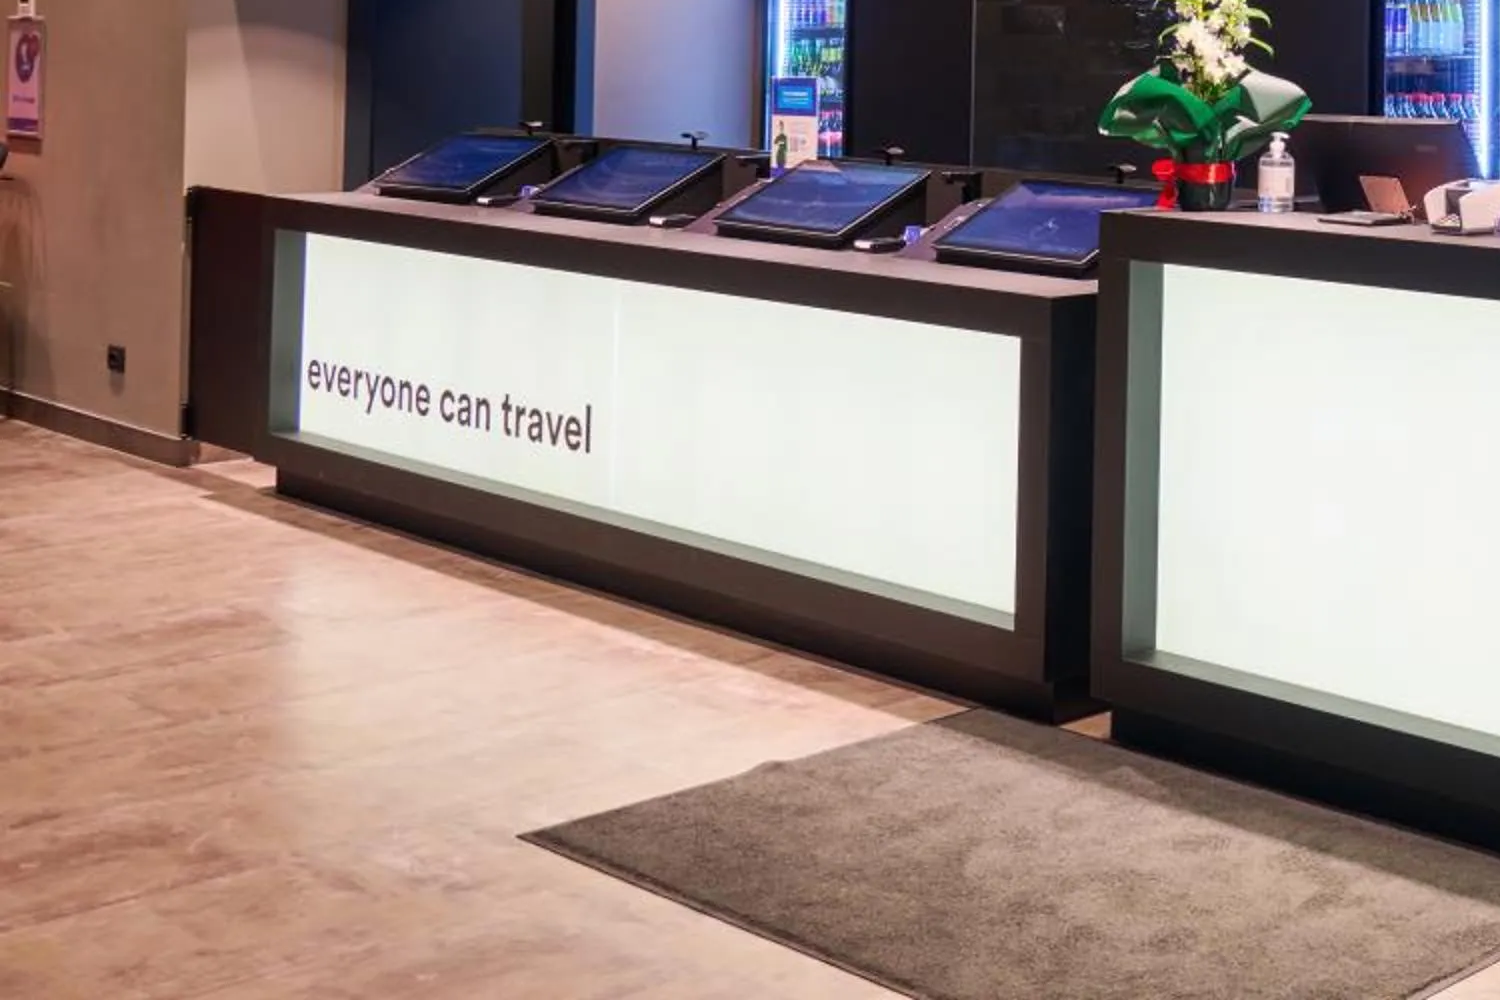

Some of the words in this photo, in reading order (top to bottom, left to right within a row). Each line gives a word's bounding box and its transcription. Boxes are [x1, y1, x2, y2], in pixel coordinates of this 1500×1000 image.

[307, 358, 431, 416] everyone
[439, 389, 491, 433] can
[501, 393, 592, 454] travel
